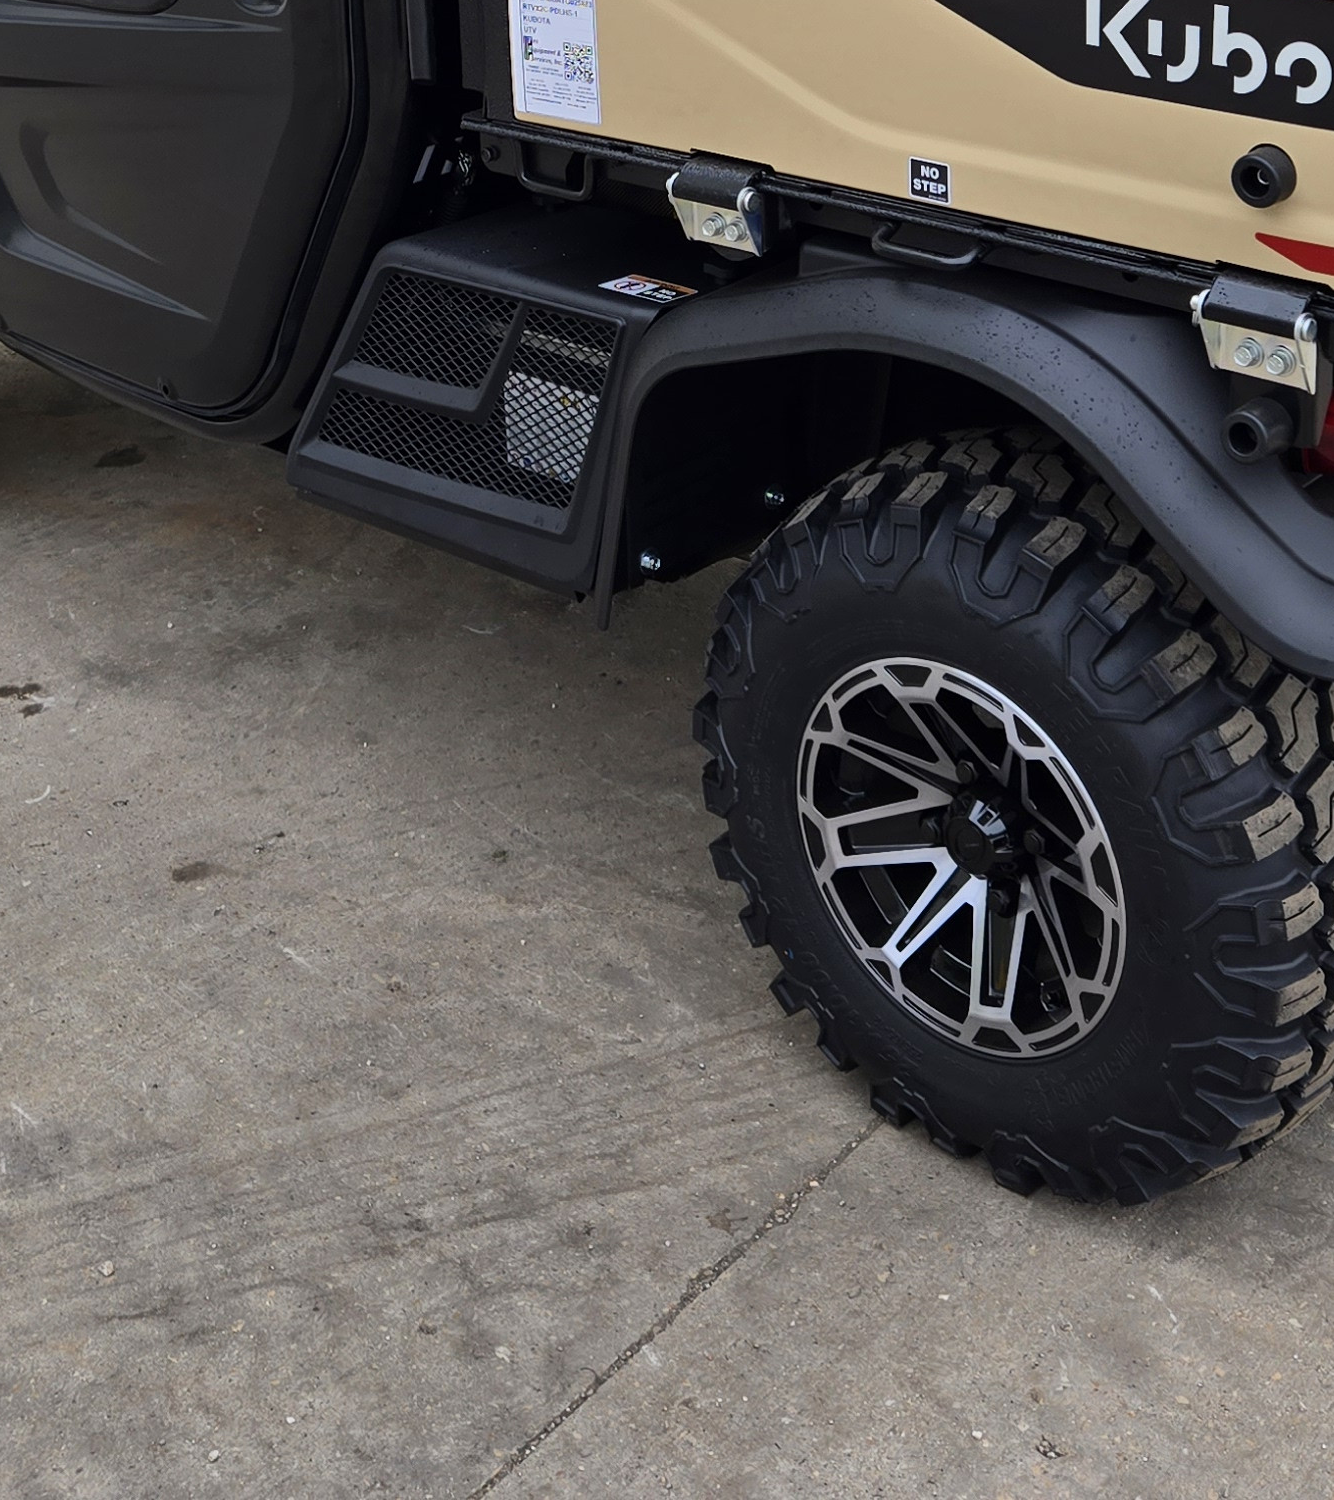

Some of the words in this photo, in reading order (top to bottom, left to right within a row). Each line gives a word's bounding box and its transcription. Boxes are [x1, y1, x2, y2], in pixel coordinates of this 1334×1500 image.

[523, 15, 551, 25] KUBOTA
[524, 26, 537, 34] UTV
[920, 165, 940, 180] NO
[913, 178, 946, 195] STEP
